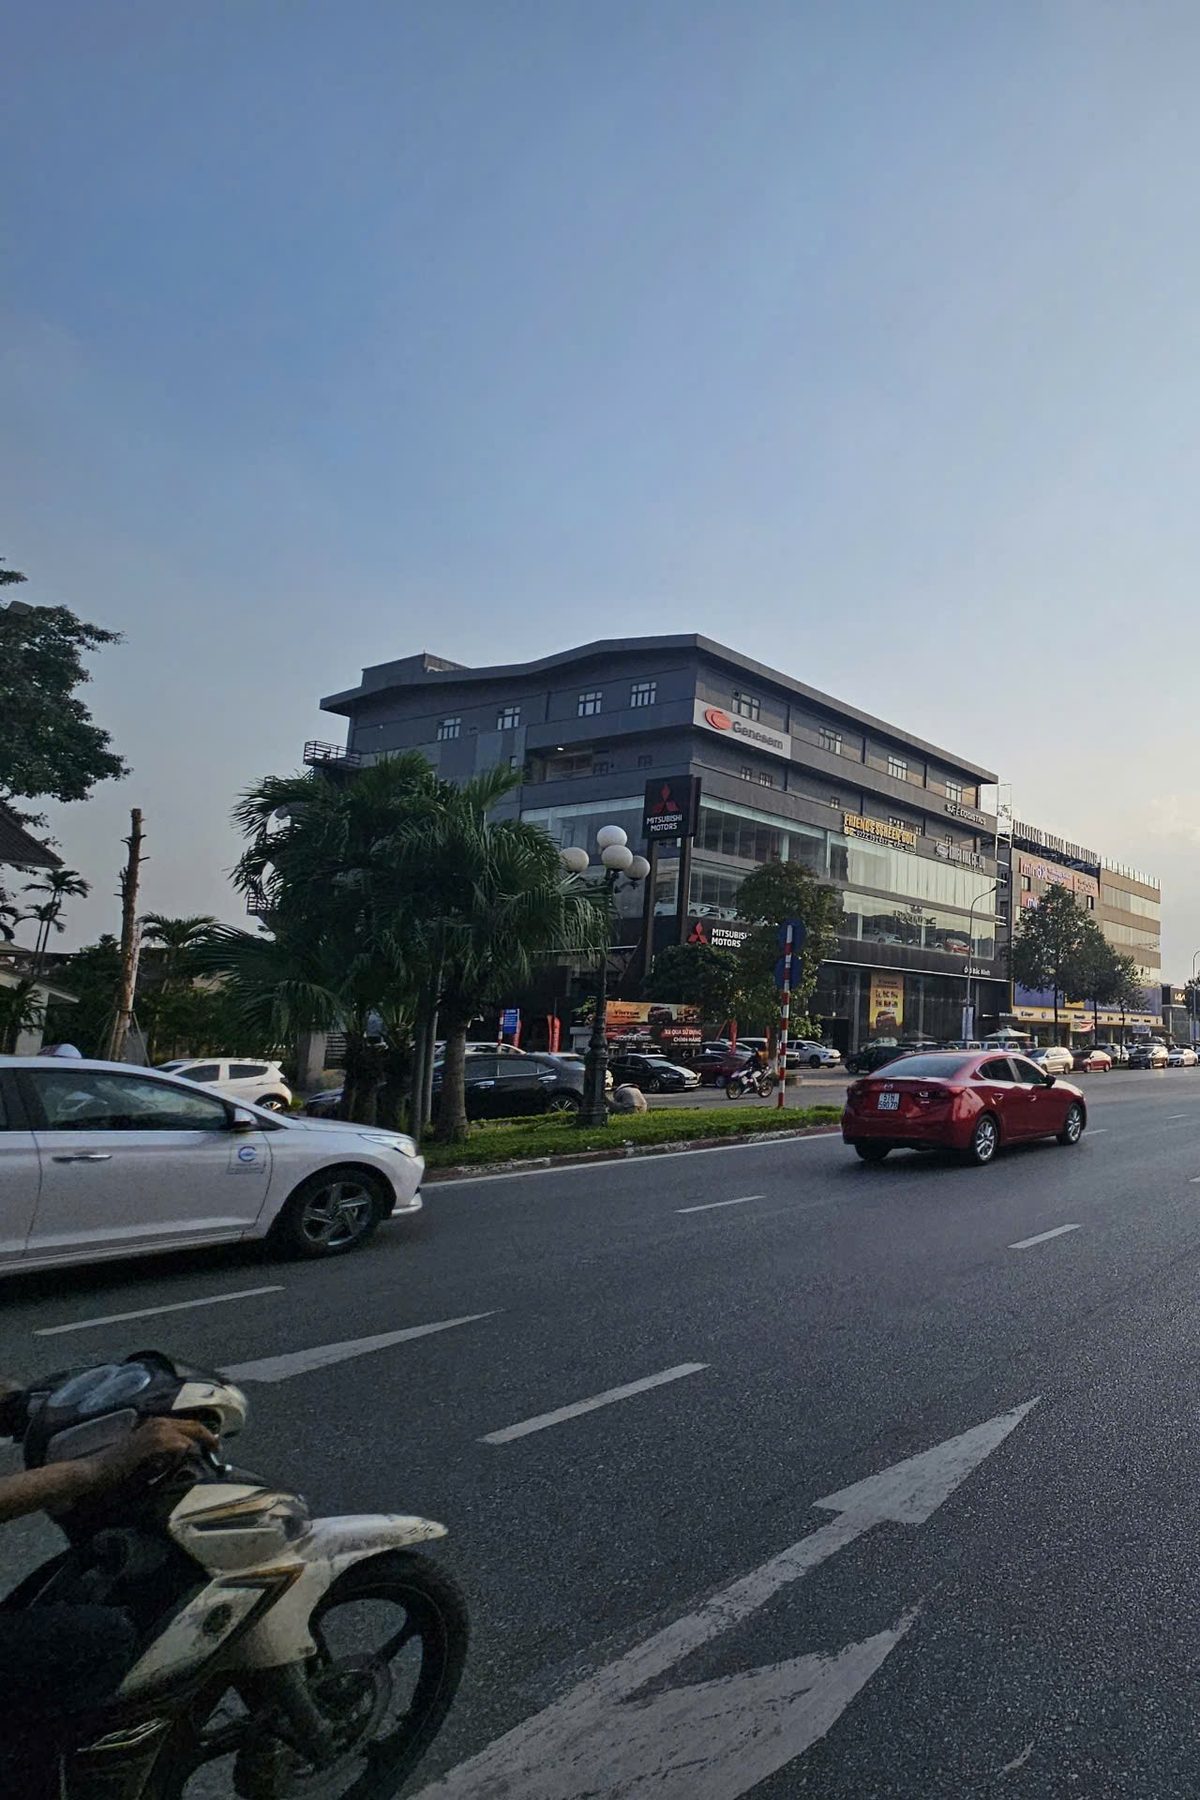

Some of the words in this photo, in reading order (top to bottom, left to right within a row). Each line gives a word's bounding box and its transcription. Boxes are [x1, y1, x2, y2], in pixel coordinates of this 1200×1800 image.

[733, 721, 784, 750] Genesem
[646, 814, 683, 825] MITSUBISHI
[651, 823, 678, 832] MOTORS
[712, 928, 752, 940] MITSUBIS
[711, 937, 741, 948] MOTORS
